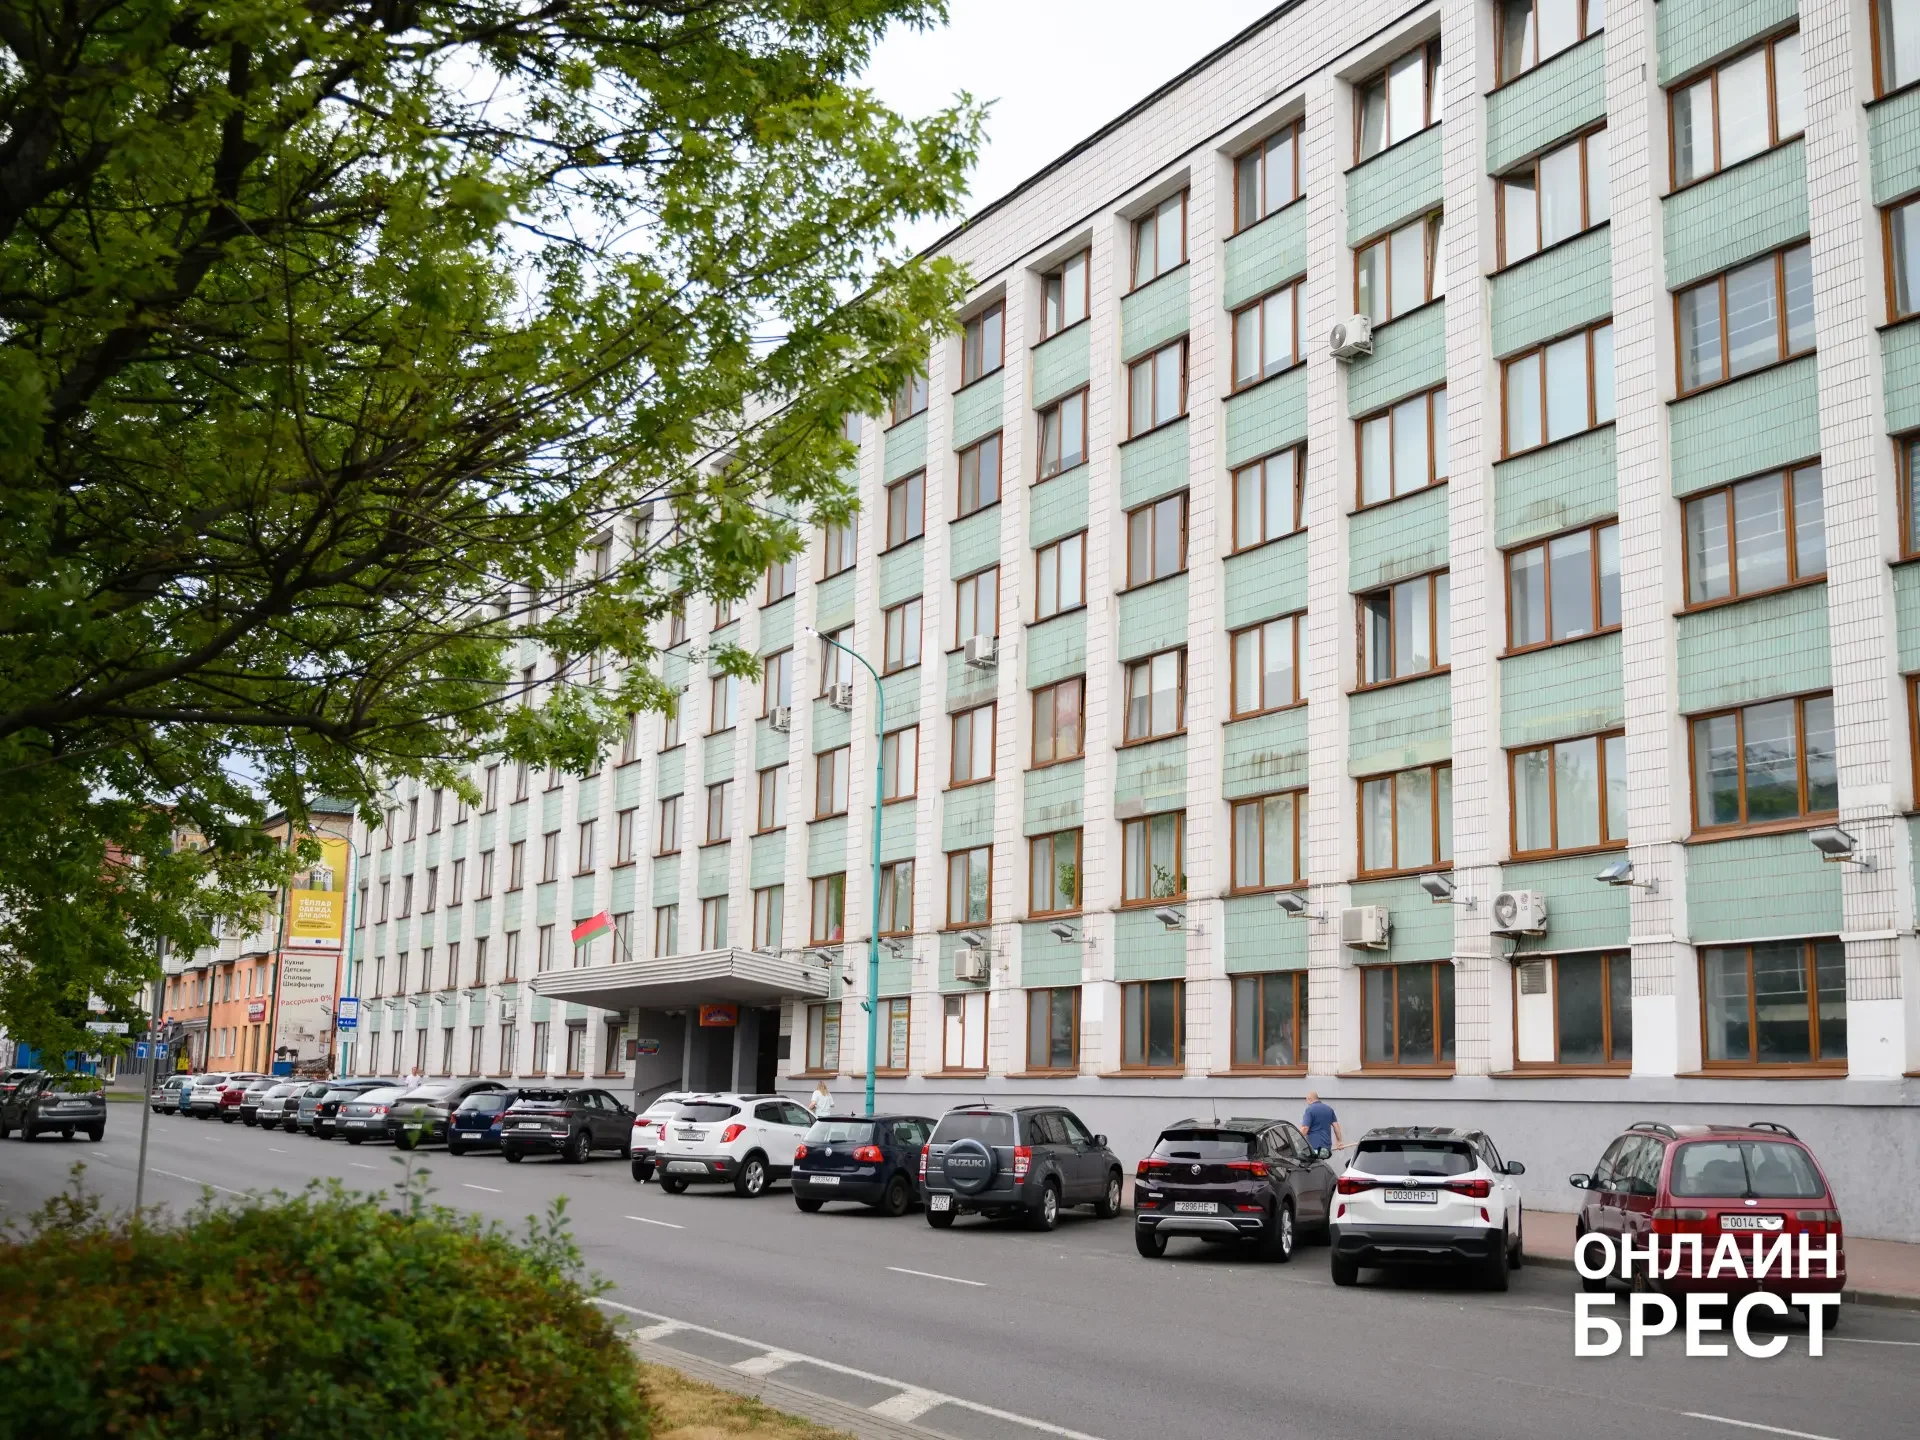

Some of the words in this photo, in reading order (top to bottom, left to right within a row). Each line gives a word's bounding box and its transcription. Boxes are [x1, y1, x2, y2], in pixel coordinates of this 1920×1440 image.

[299, 898, 332, 907] ТЁПЛАЯ
[283, 966, 311, 974] Детские
[282, 981, 325, 989] Шкафы-купе
[280, 997, 319, 1006] Рассрочка
[320, 994, 333, 1003] 0%
[947, 1158, 986, 1167] SUZUKI
[1393, 1190, 1412, 1200] 0030
[1730, 1217, 1754, 1228] 0014
